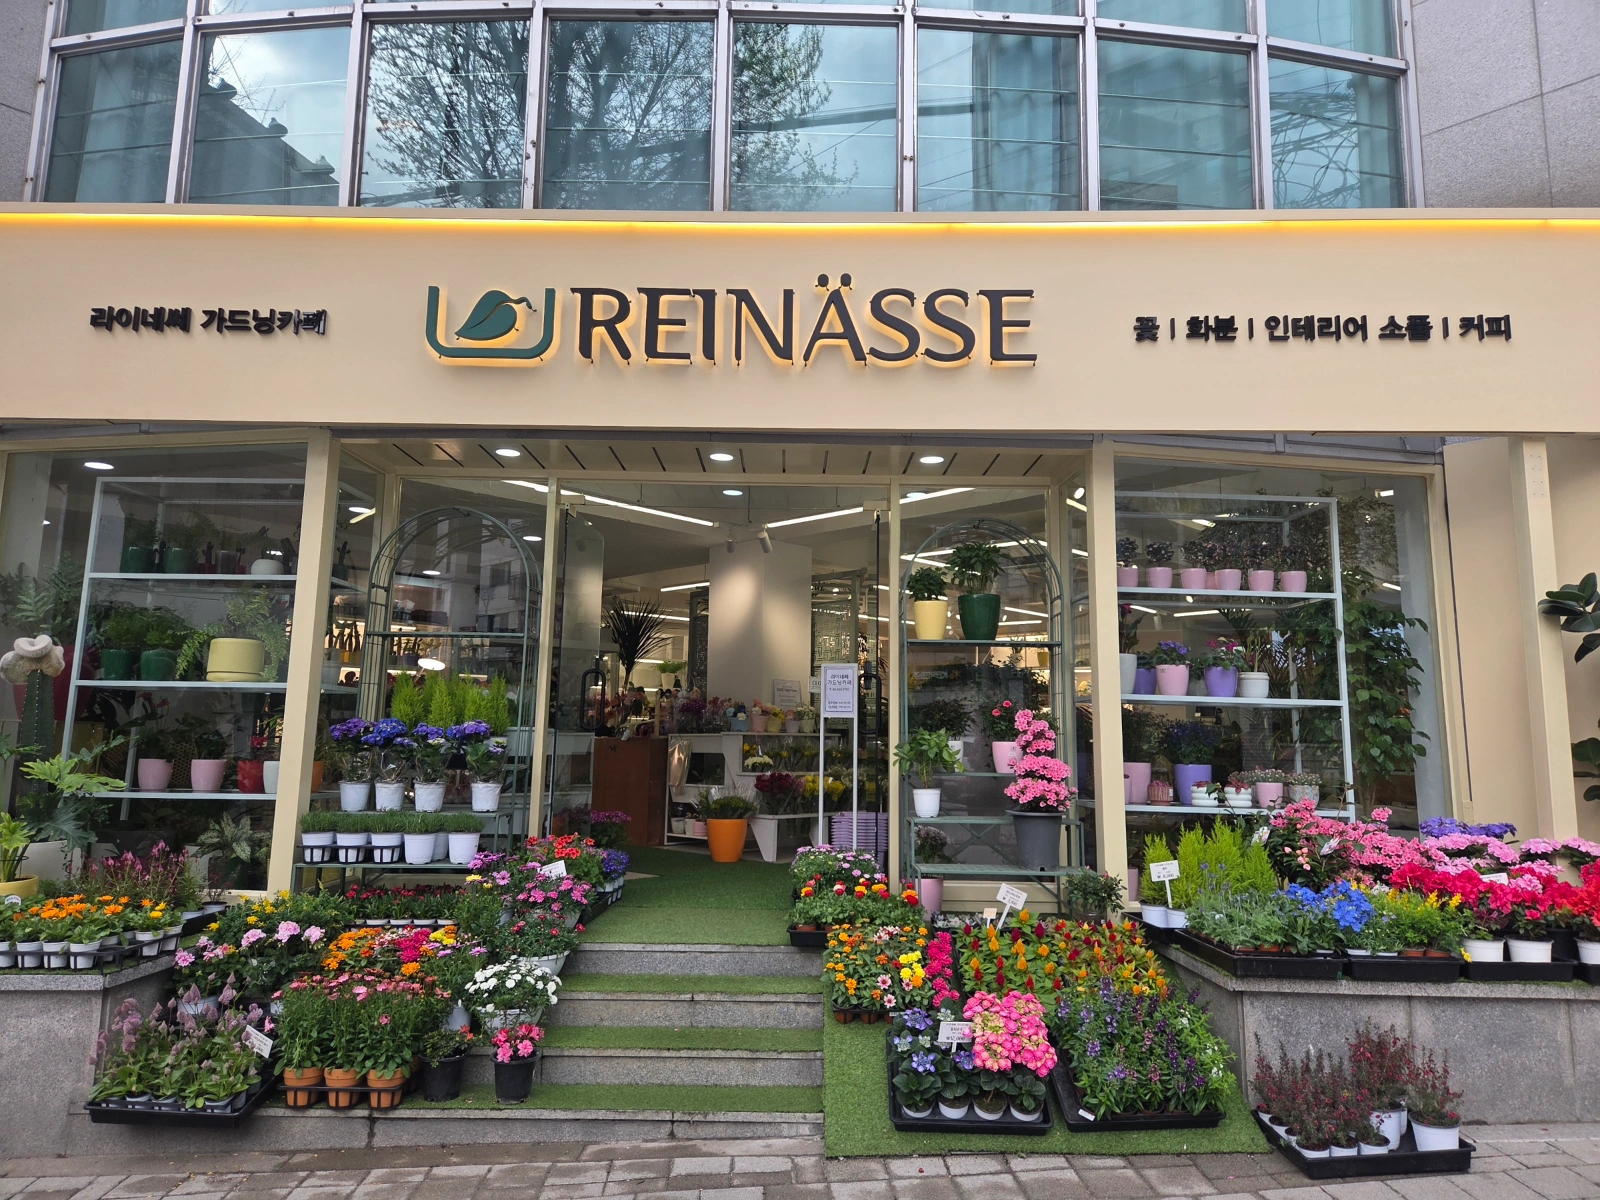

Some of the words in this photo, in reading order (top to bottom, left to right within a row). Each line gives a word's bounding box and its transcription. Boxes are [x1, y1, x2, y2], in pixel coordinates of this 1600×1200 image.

[90, 306, 192, 332] 라이네쎄
[200, 308, 327, 335] 가드닝카페
[570, 273, 1038, 365] REINÄSSE
[1133, 316, 1160, 341] 꽃
[1186, 315, 1238, 342] 화분
[1264, 315, 1368, 341] 인테리어
[1379, 315, 1433, 341] 소품
[1459, 314, 1512, 341] 커피
